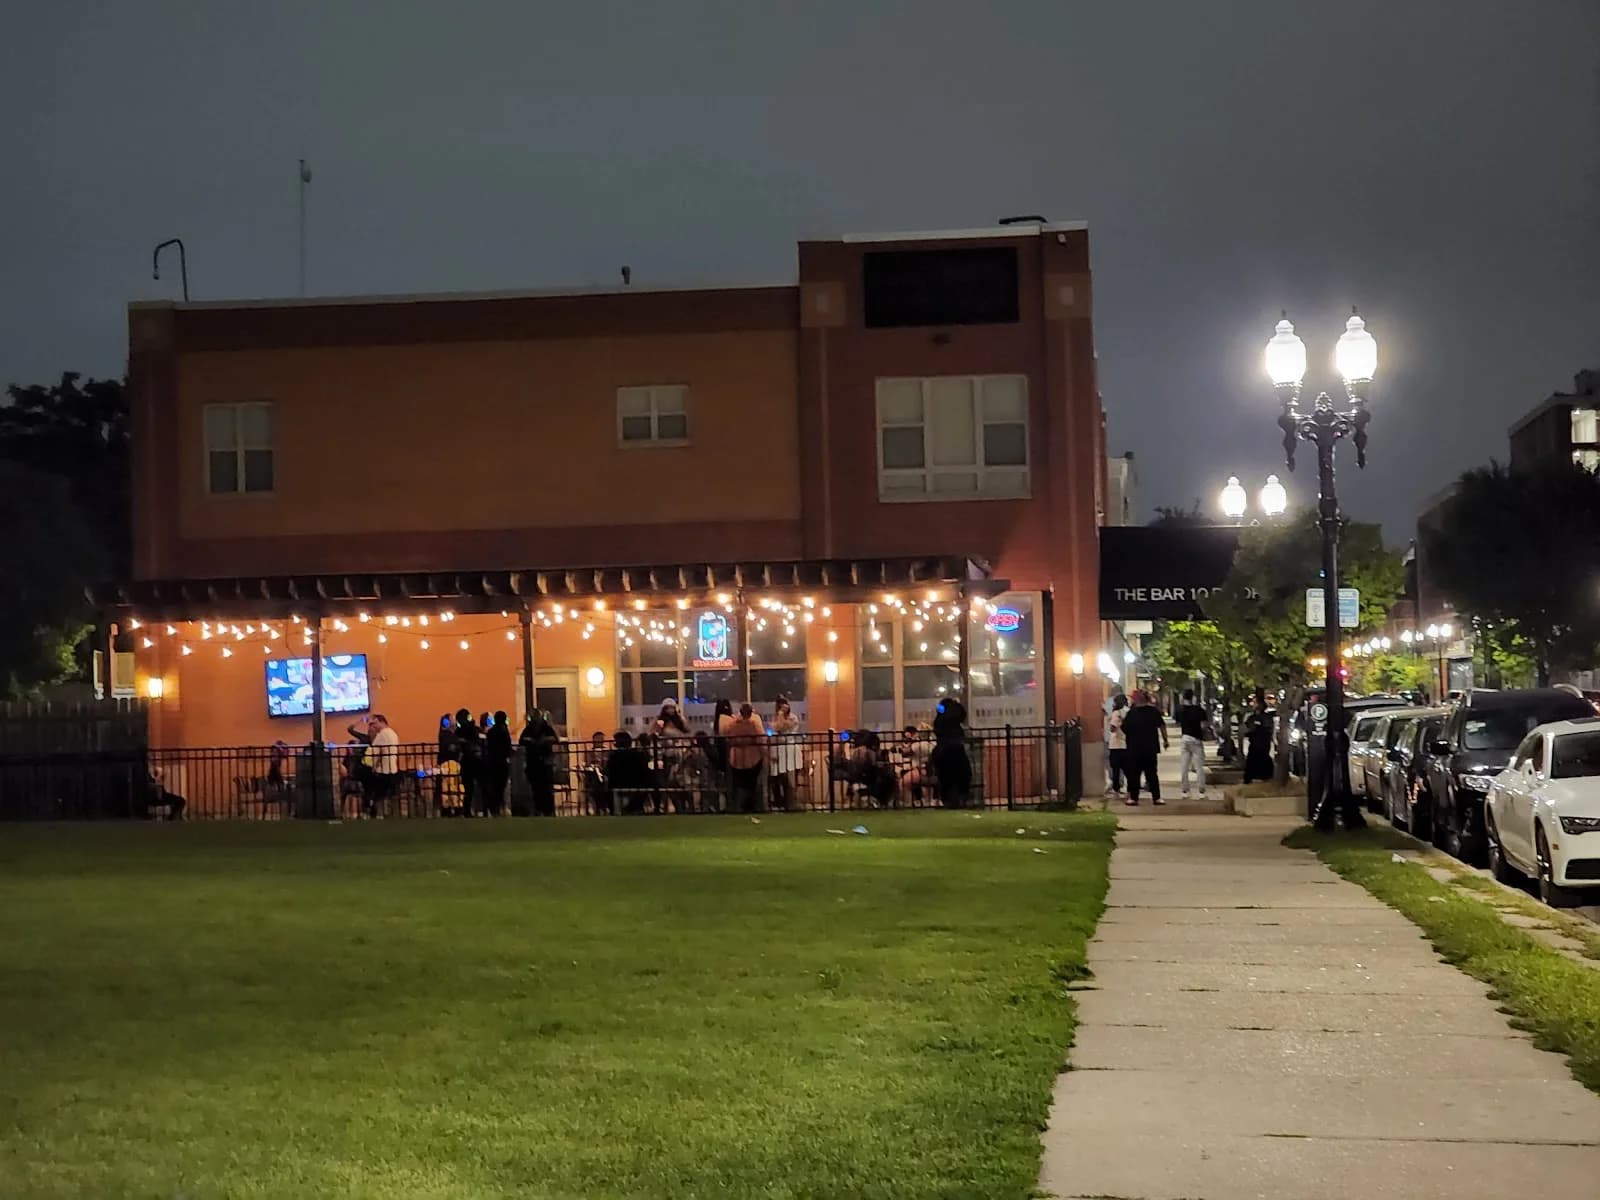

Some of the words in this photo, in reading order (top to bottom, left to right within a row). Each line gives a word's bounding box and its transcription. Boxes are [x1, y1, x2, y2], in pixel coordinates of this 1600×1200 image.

[1113, 587, 1148, 601] THE
[1150, 587, 1185, 601] BAR
[988, 614, 1019, 626] OPEN
